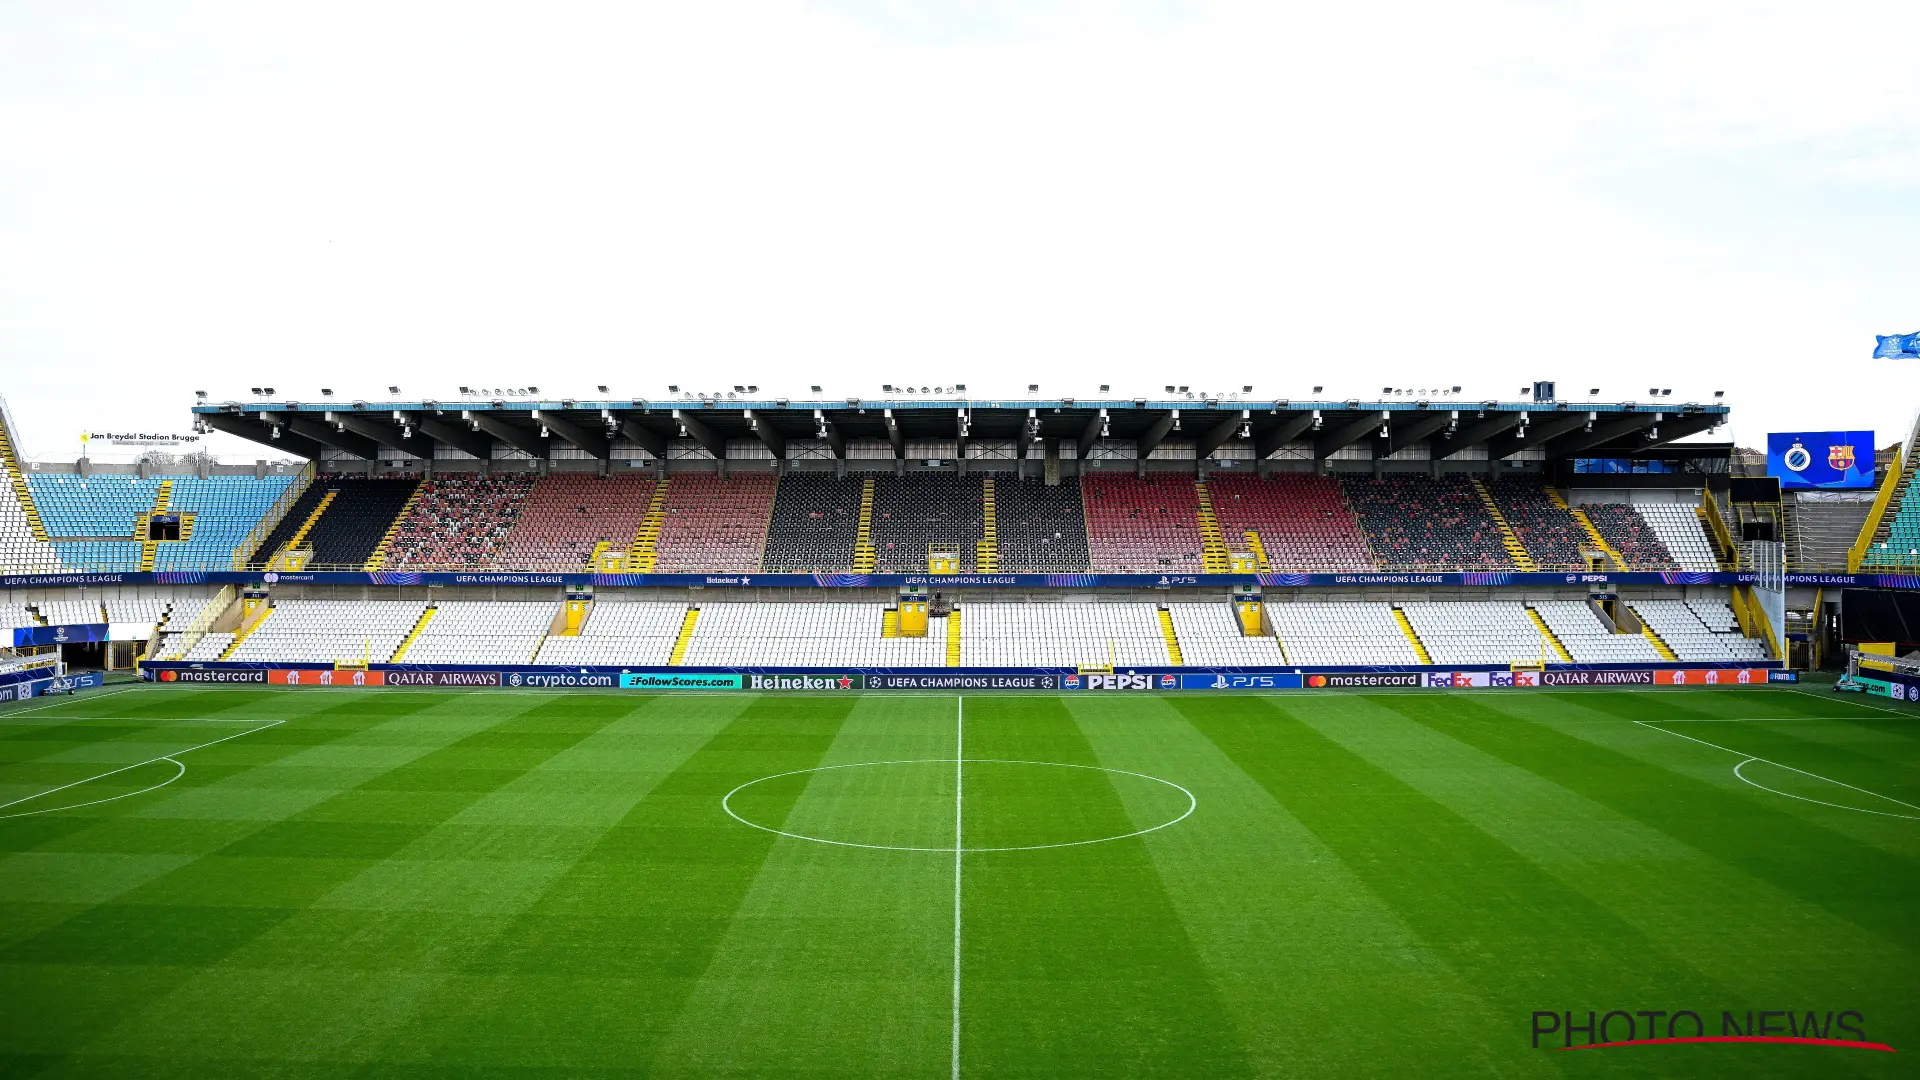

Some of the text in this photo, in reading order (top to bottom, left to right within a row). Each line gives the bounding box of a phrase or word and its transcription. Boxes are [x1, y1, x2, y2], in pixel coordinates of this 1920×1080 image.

[107, 433, 137, 441] Breydel
[172, 434, 200, 442] Brugge
[4, 577, 27, 585] UEFA
[30, 576, 84, 584] CHAMPIONS
[280, 572, 314, 581] mastercard
[479, 575, 529, 583] CHAMPIONS
[1335, 575, 1443, 583] UEFA CHAMPIONS LEAGUE
[1762, 575, 1817, 583] CHAMPIONS
[1819, 576, 1856, 584] LEAGUE
[181, 670, 263, 682] mastercard
[388, 672, 497, 685] QATAR AIRWAYS
[526, 674, 612, 687] crypto.com
[634, 676, 734, 687] FollowScores.com
[1233, 676, 1274, 687] PS5
[1330, 674, 1416, 685] mastercard
[1428, 672, 1472, 687] FedEx
[1489, 672, 1534, 686] FedEx
[1544, 672, 1650, 685] QATAR AIRWAYS
[750, 675, 836, 689] Heineken
[887, 677, 1036, 687] UEFA CHAMPIONS LEAGUE
[1088, 675, 1153, 689] PEPSI
